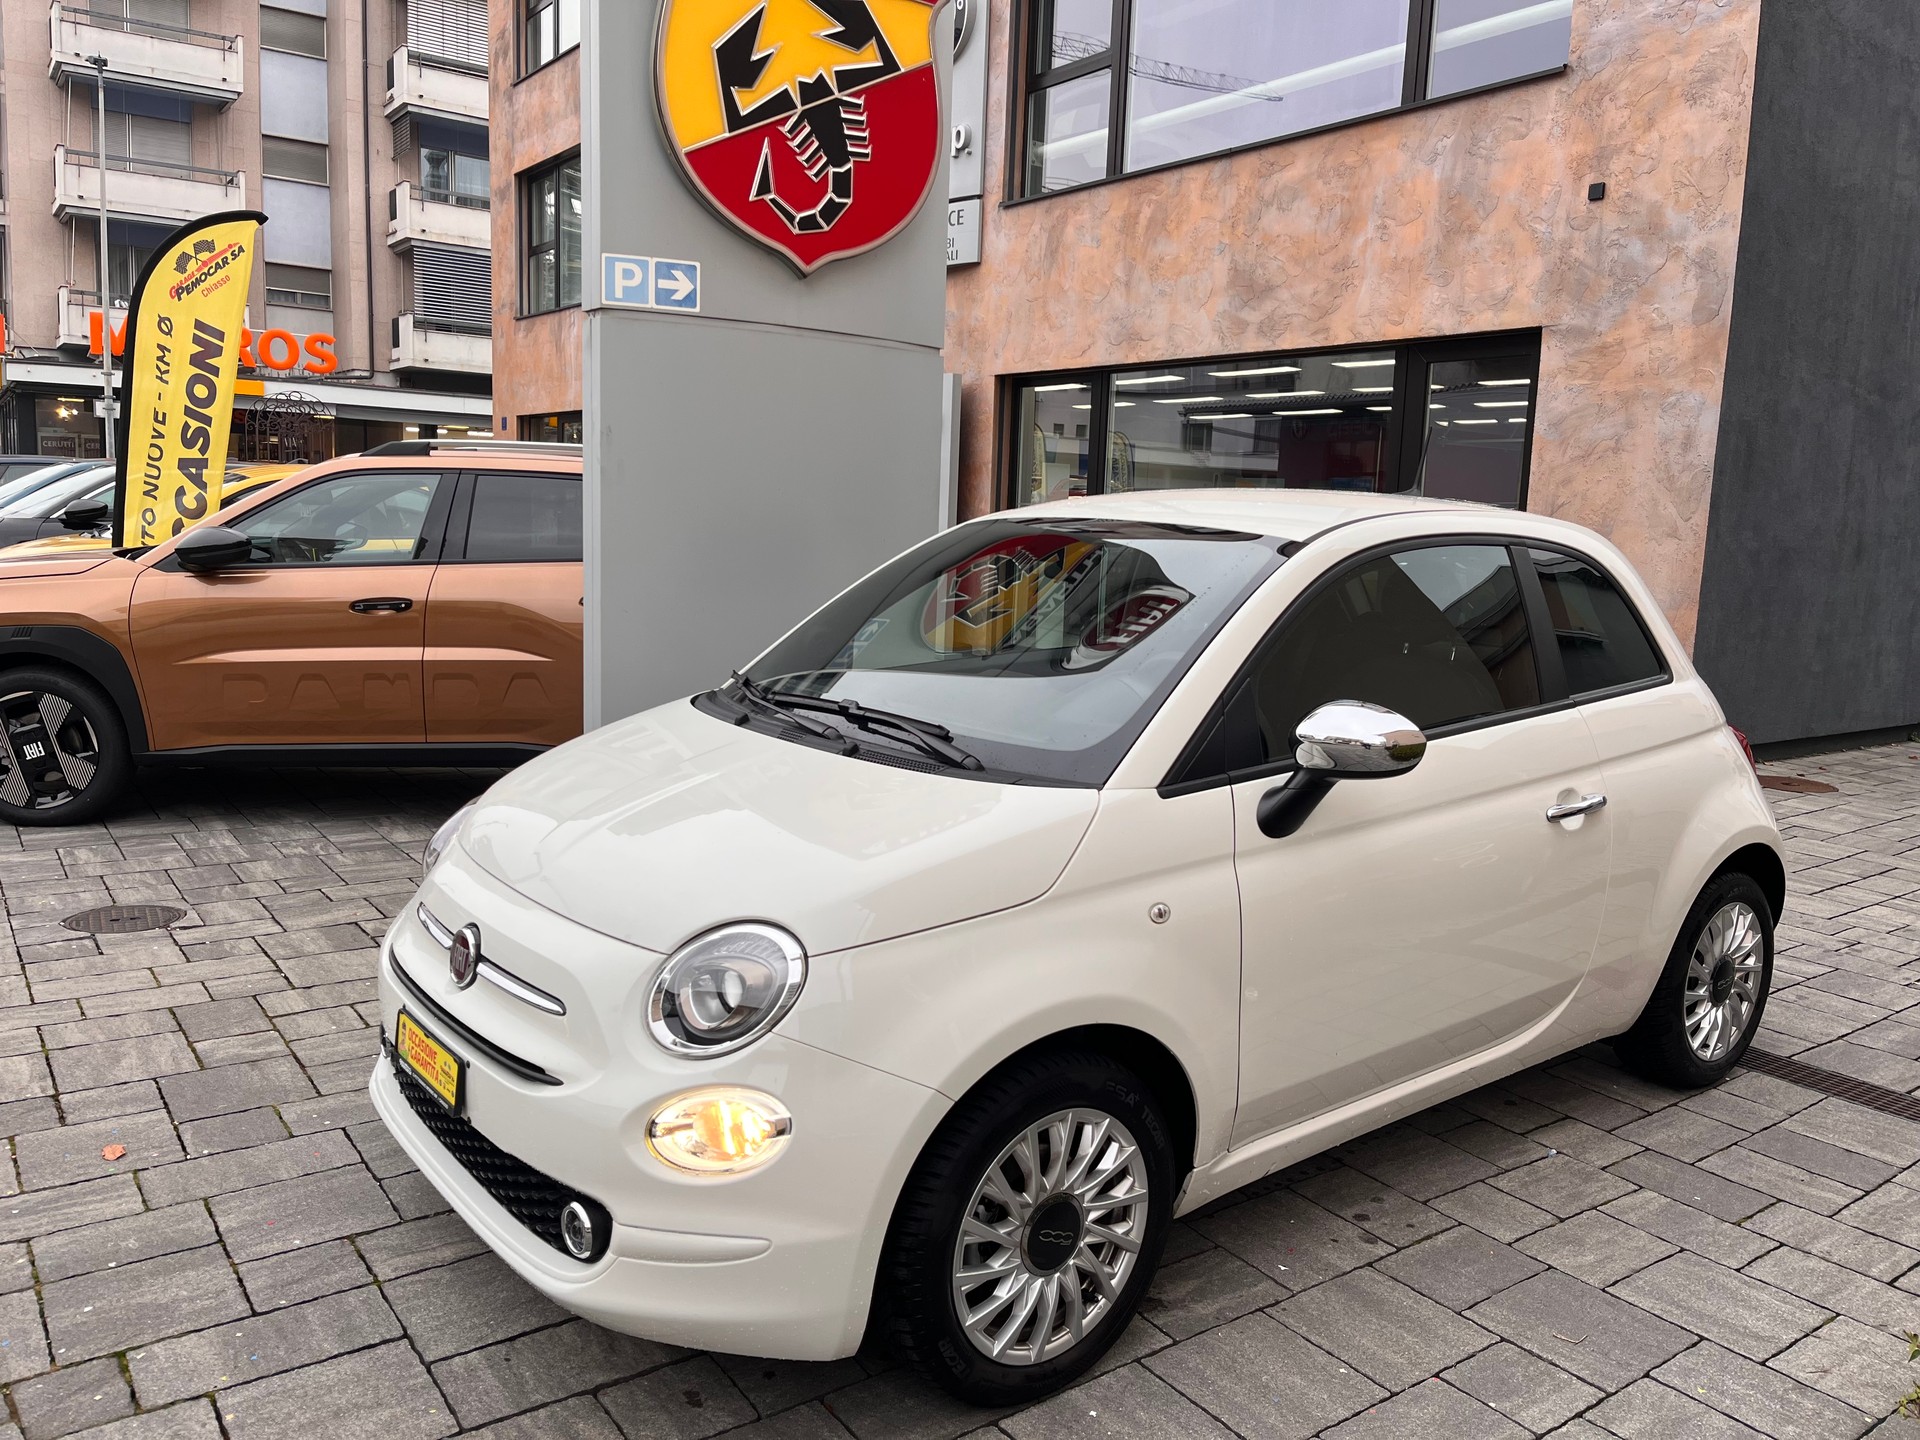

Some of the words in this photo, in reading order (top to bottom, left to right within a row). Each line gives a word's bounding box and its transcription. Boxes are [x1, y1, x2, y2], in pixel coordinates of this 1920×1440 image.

[175, 256, 230, 302] PEMOCAR
[230, 244, 246, 262] SA
[201, 274, 231, 298] Chiasso
[614, 261, 643, 299] P
[89, 312, 338, 374] MROS
[42, 440, 75, 448] CERUTTI
[142, 407, 167, 502] NUOVE
[155, 342, 172, 385] KM
[171, 318, 226, 538] CASIONI
[23, 741, 46, 761] FIAT
